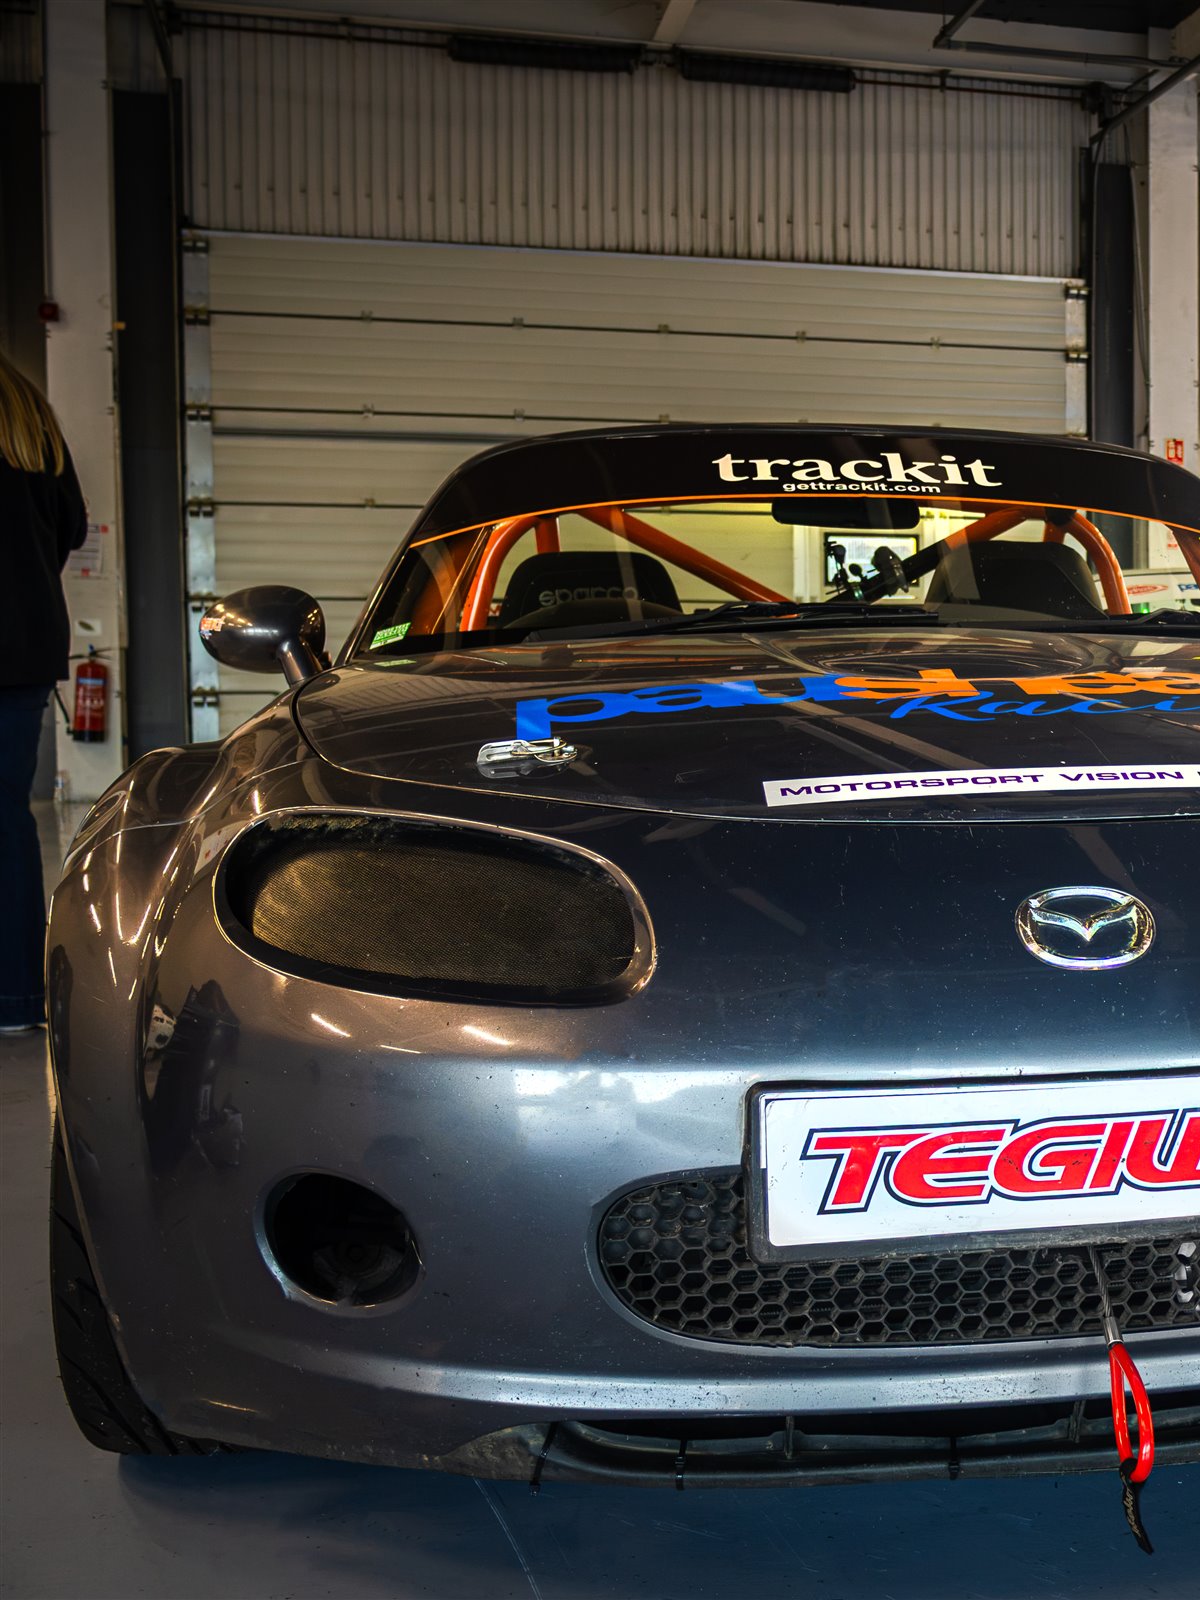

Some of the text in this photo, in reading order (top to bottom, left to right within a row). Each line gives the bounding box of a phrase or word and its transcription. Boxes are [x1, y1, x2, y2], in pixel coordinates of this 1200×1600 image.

[711, 452, 1003, 487] trackit
[782, 481, 941, 494] gettrackit.com
[538, 586, 640, 607] sparco
[779, 774, 1044, 797] MOTORSPORT
[1058, 770, 1185, 782] VISION
